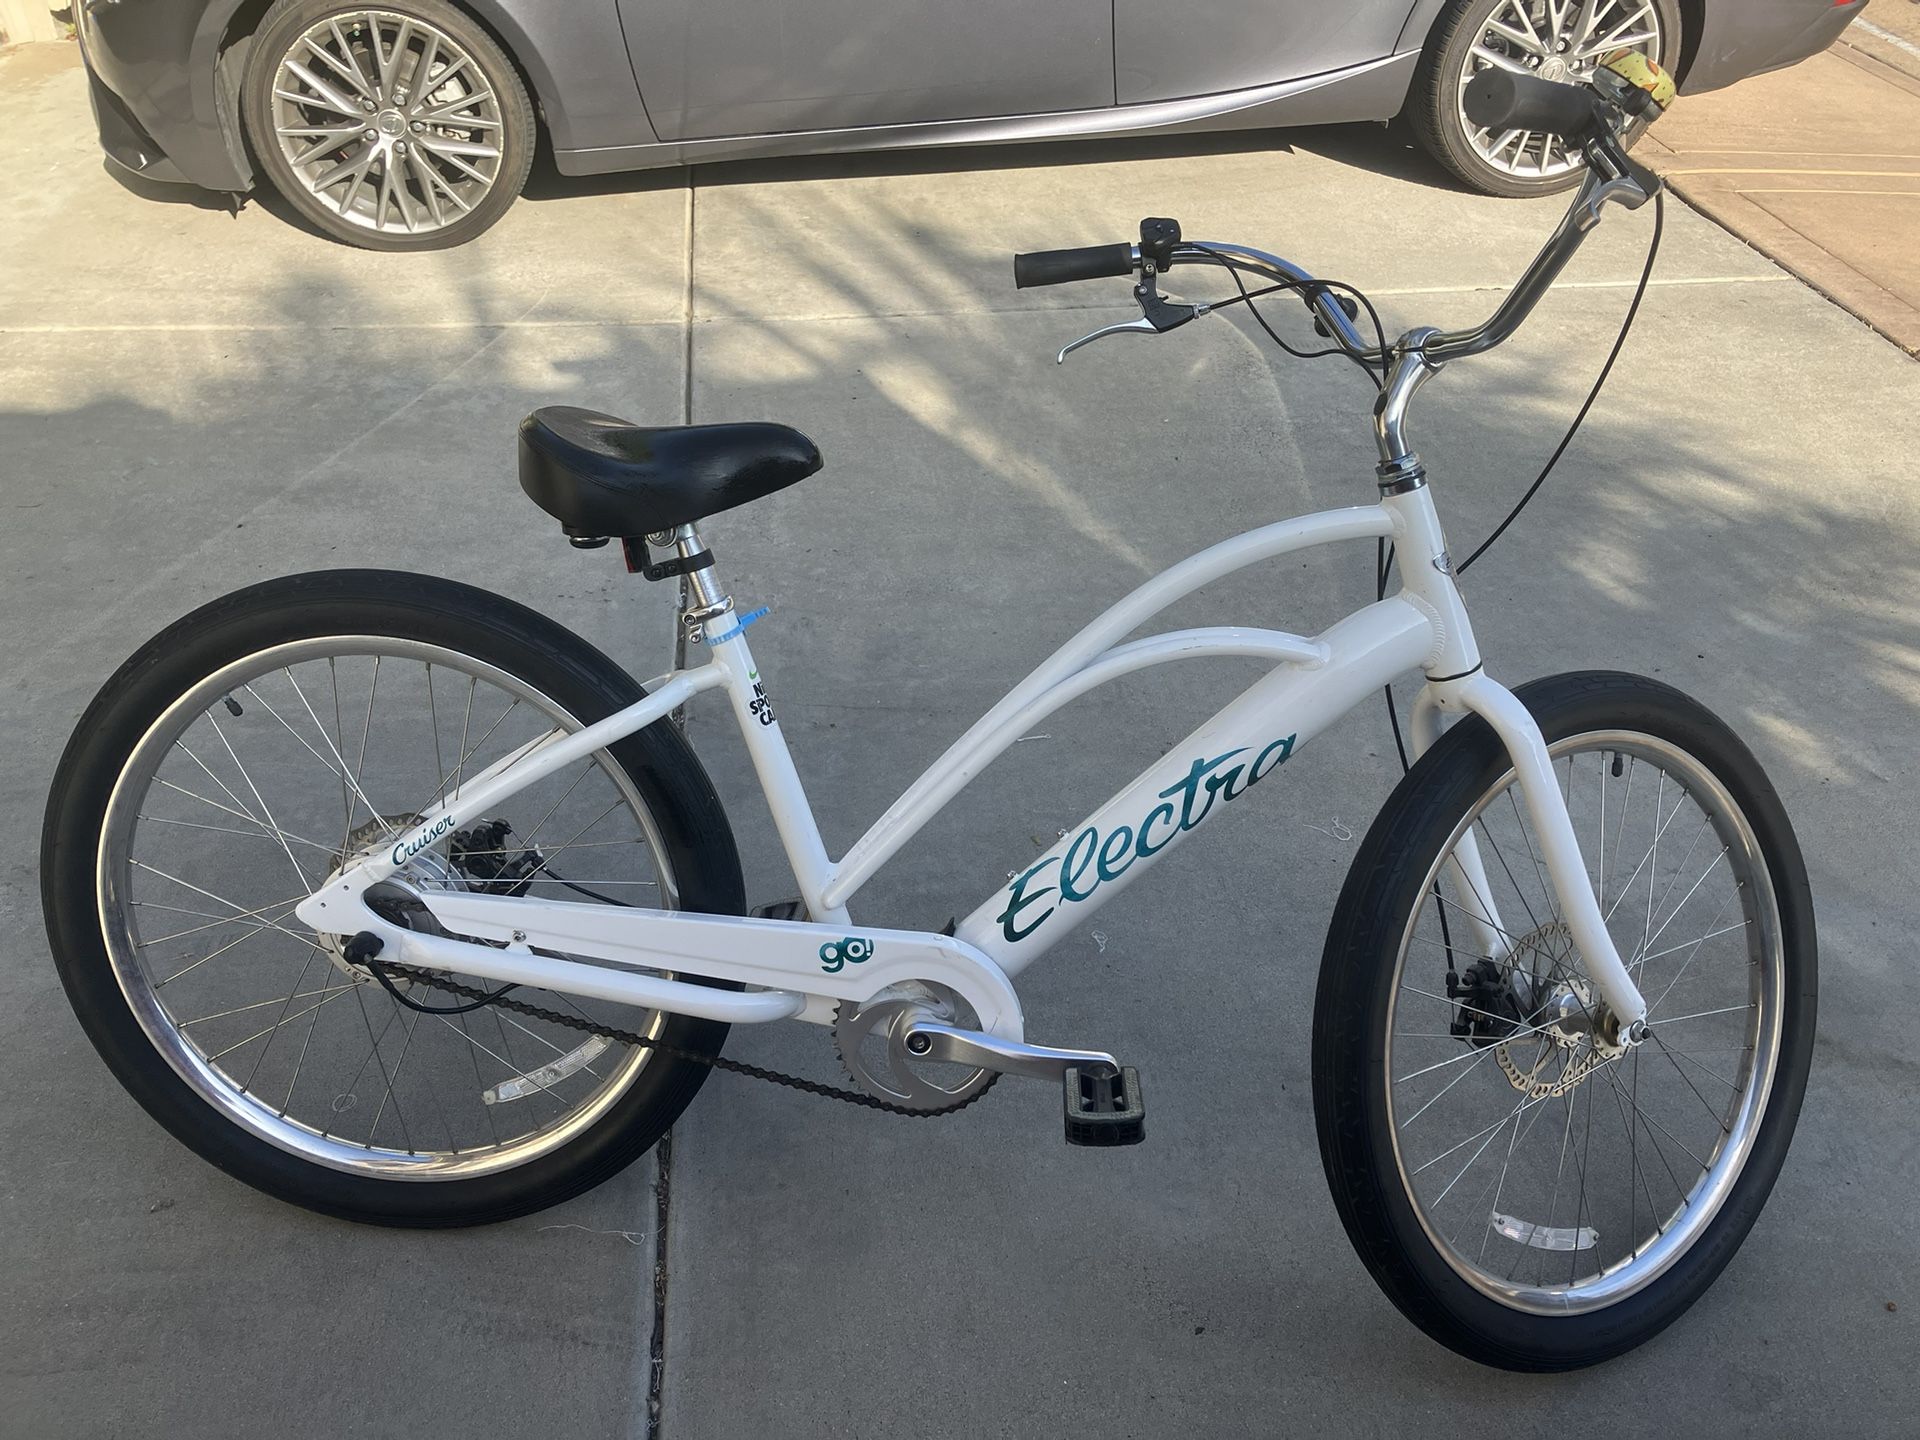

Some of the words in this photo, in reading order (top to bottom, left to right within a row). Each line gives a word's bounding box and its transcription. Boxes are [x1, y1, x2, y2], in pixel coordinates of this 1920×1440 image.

[392, 814, 456, 866] Cruiser
[996, 733, 1297, 942] Electra
[819, 937, 874, 973] go!
